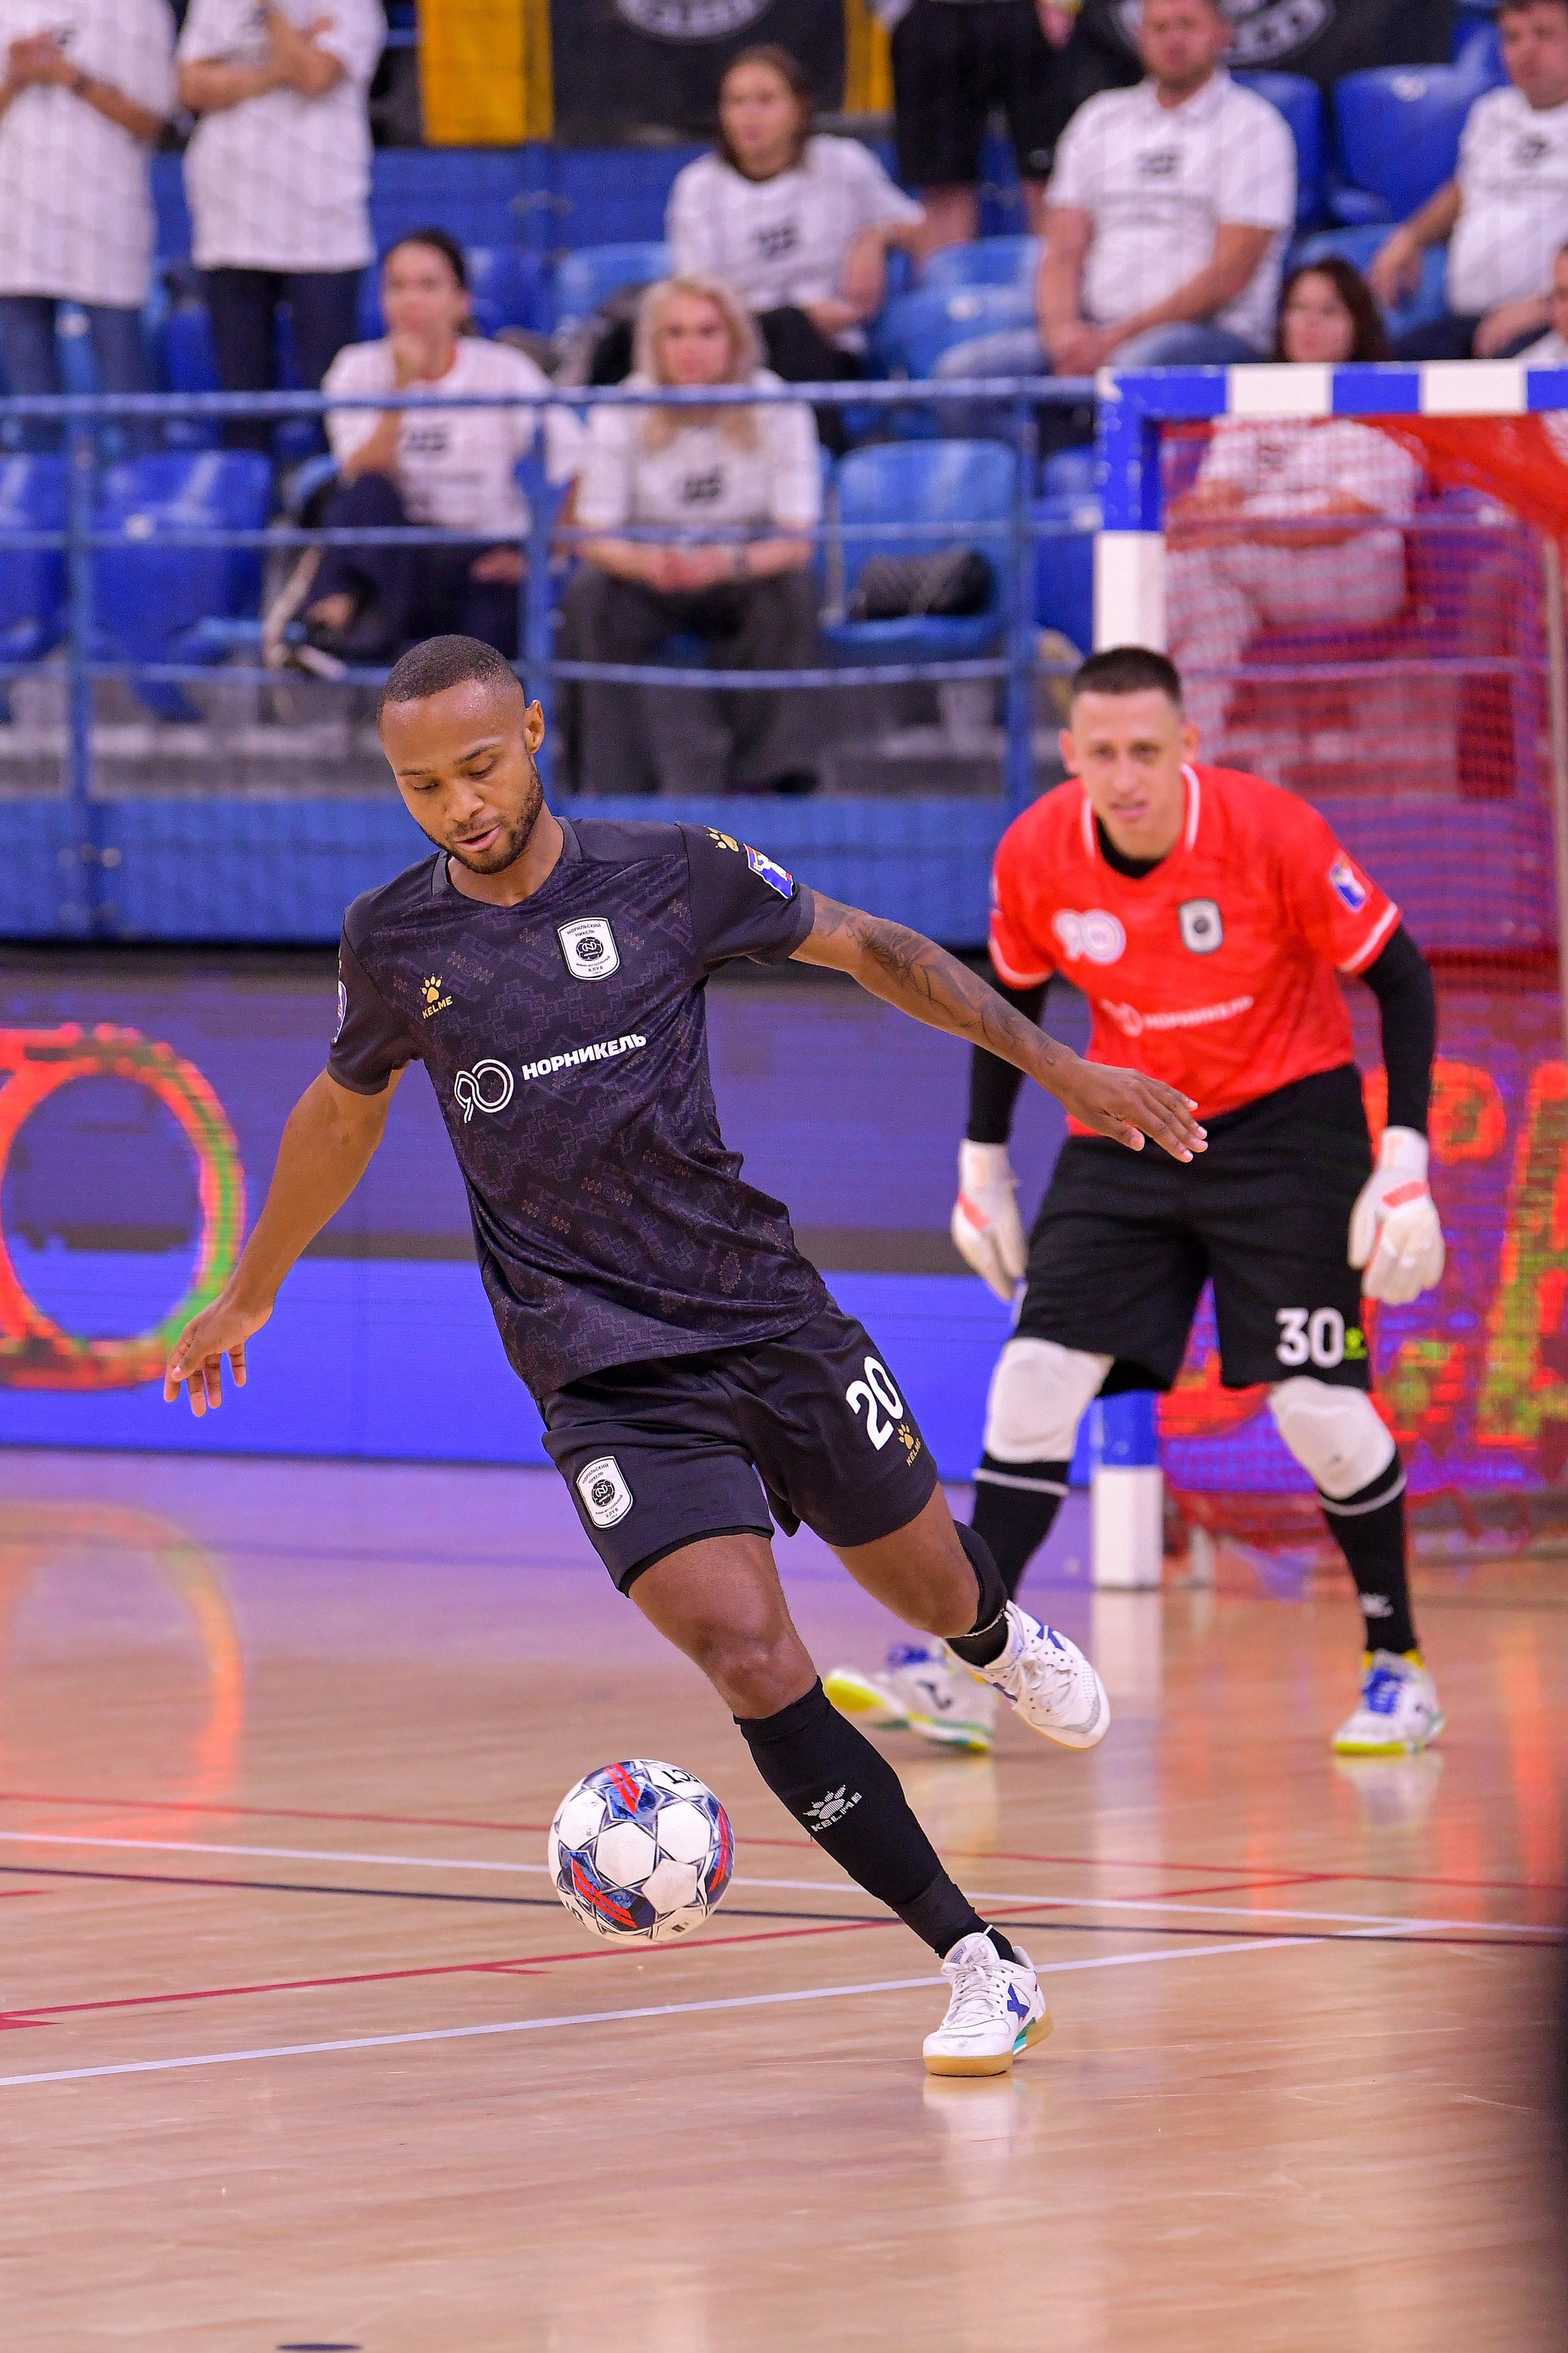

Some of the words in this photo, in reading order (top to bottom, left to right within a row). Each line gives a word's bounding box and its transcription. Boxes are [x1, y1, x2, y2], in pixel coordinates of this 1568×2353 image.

[566, 923, 601, 935] НОРИЛЬСКИЙ
[422, 995, 453, 1019] KELME
[522, 1033, 647, 1081] НОРНИКЕЛЬ
[1275, 1306, 1346, 1369] 30
[845, 1356, 904, 1451] 20
[906, 1438, 921, 1467] KELME
[811, 1792, 862, 1832] KELME
